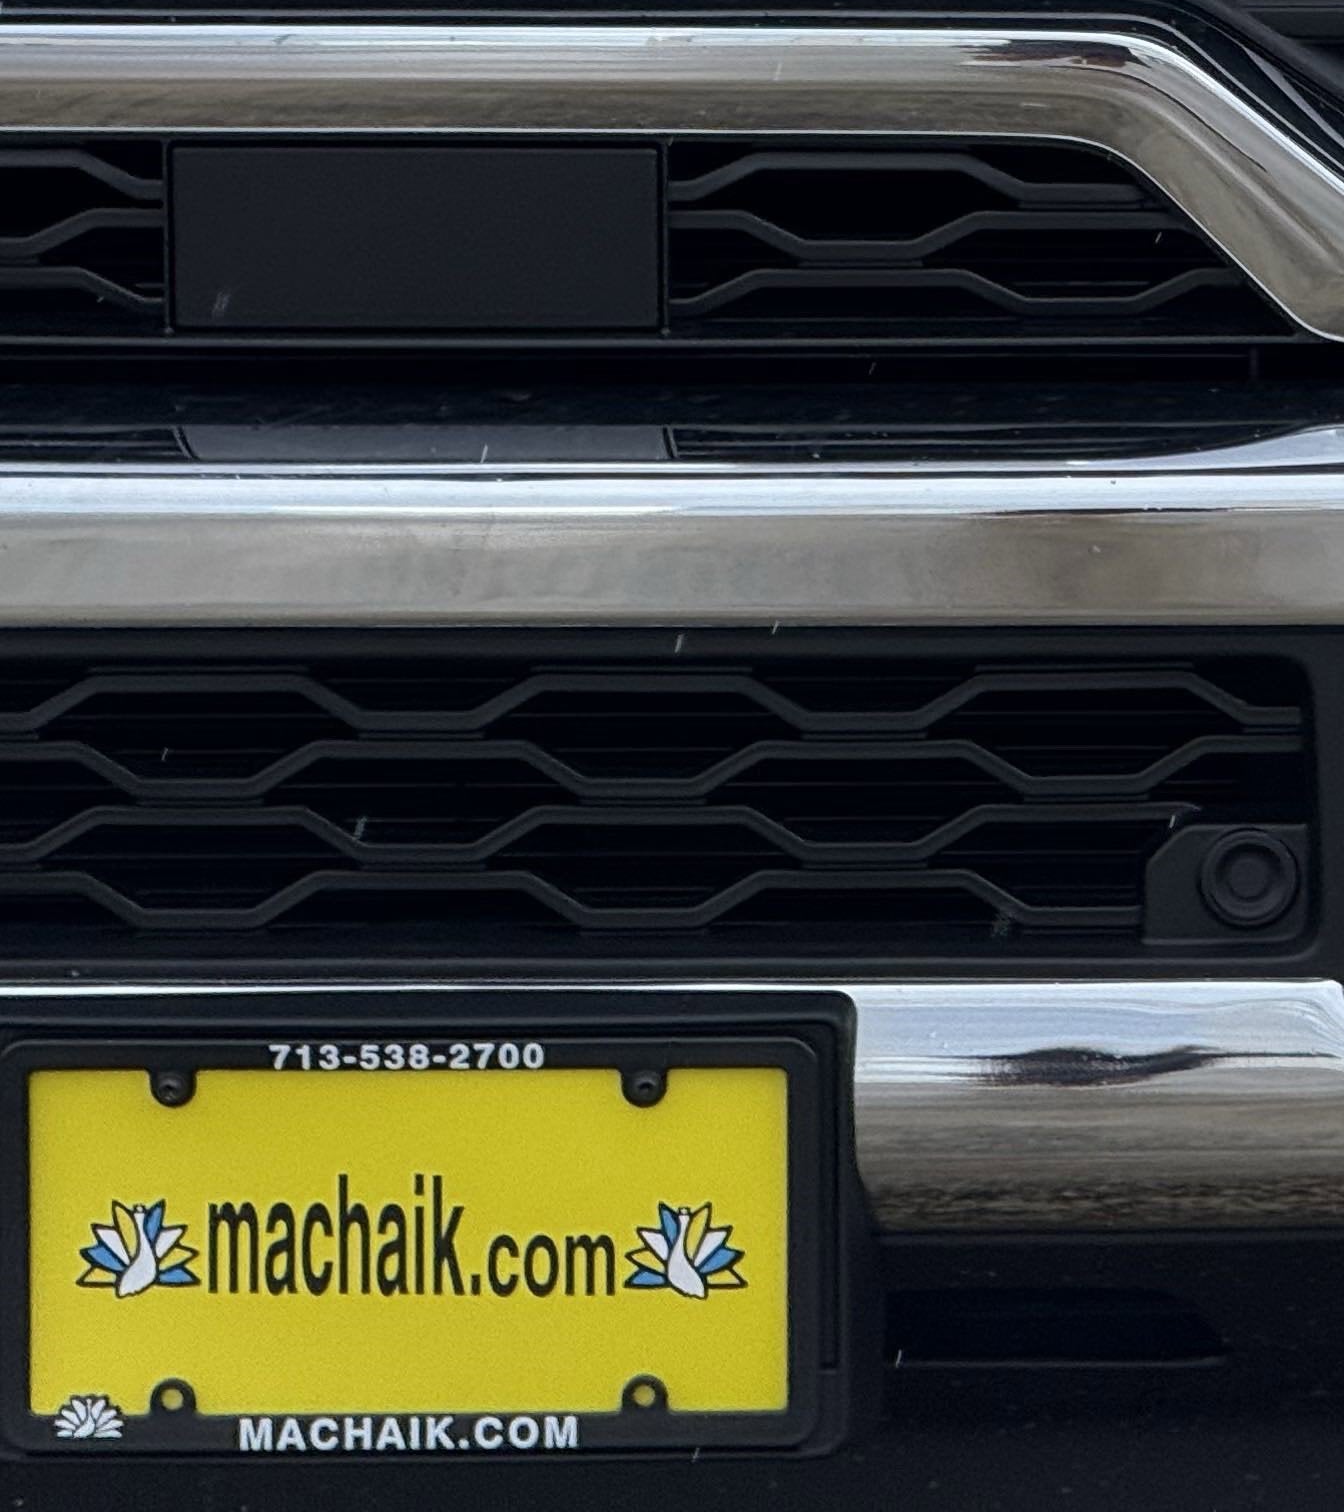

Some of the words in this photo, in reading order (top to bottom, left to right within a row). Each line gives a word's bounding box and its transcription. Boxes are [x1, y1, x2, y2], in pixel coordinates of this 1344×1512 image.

[269, 1043, 545, 1070] 713-538-2700
[207, 1173, 617, 1297] machaik.com
[238, 1415, 579, 1451] MACHAIK.COM
